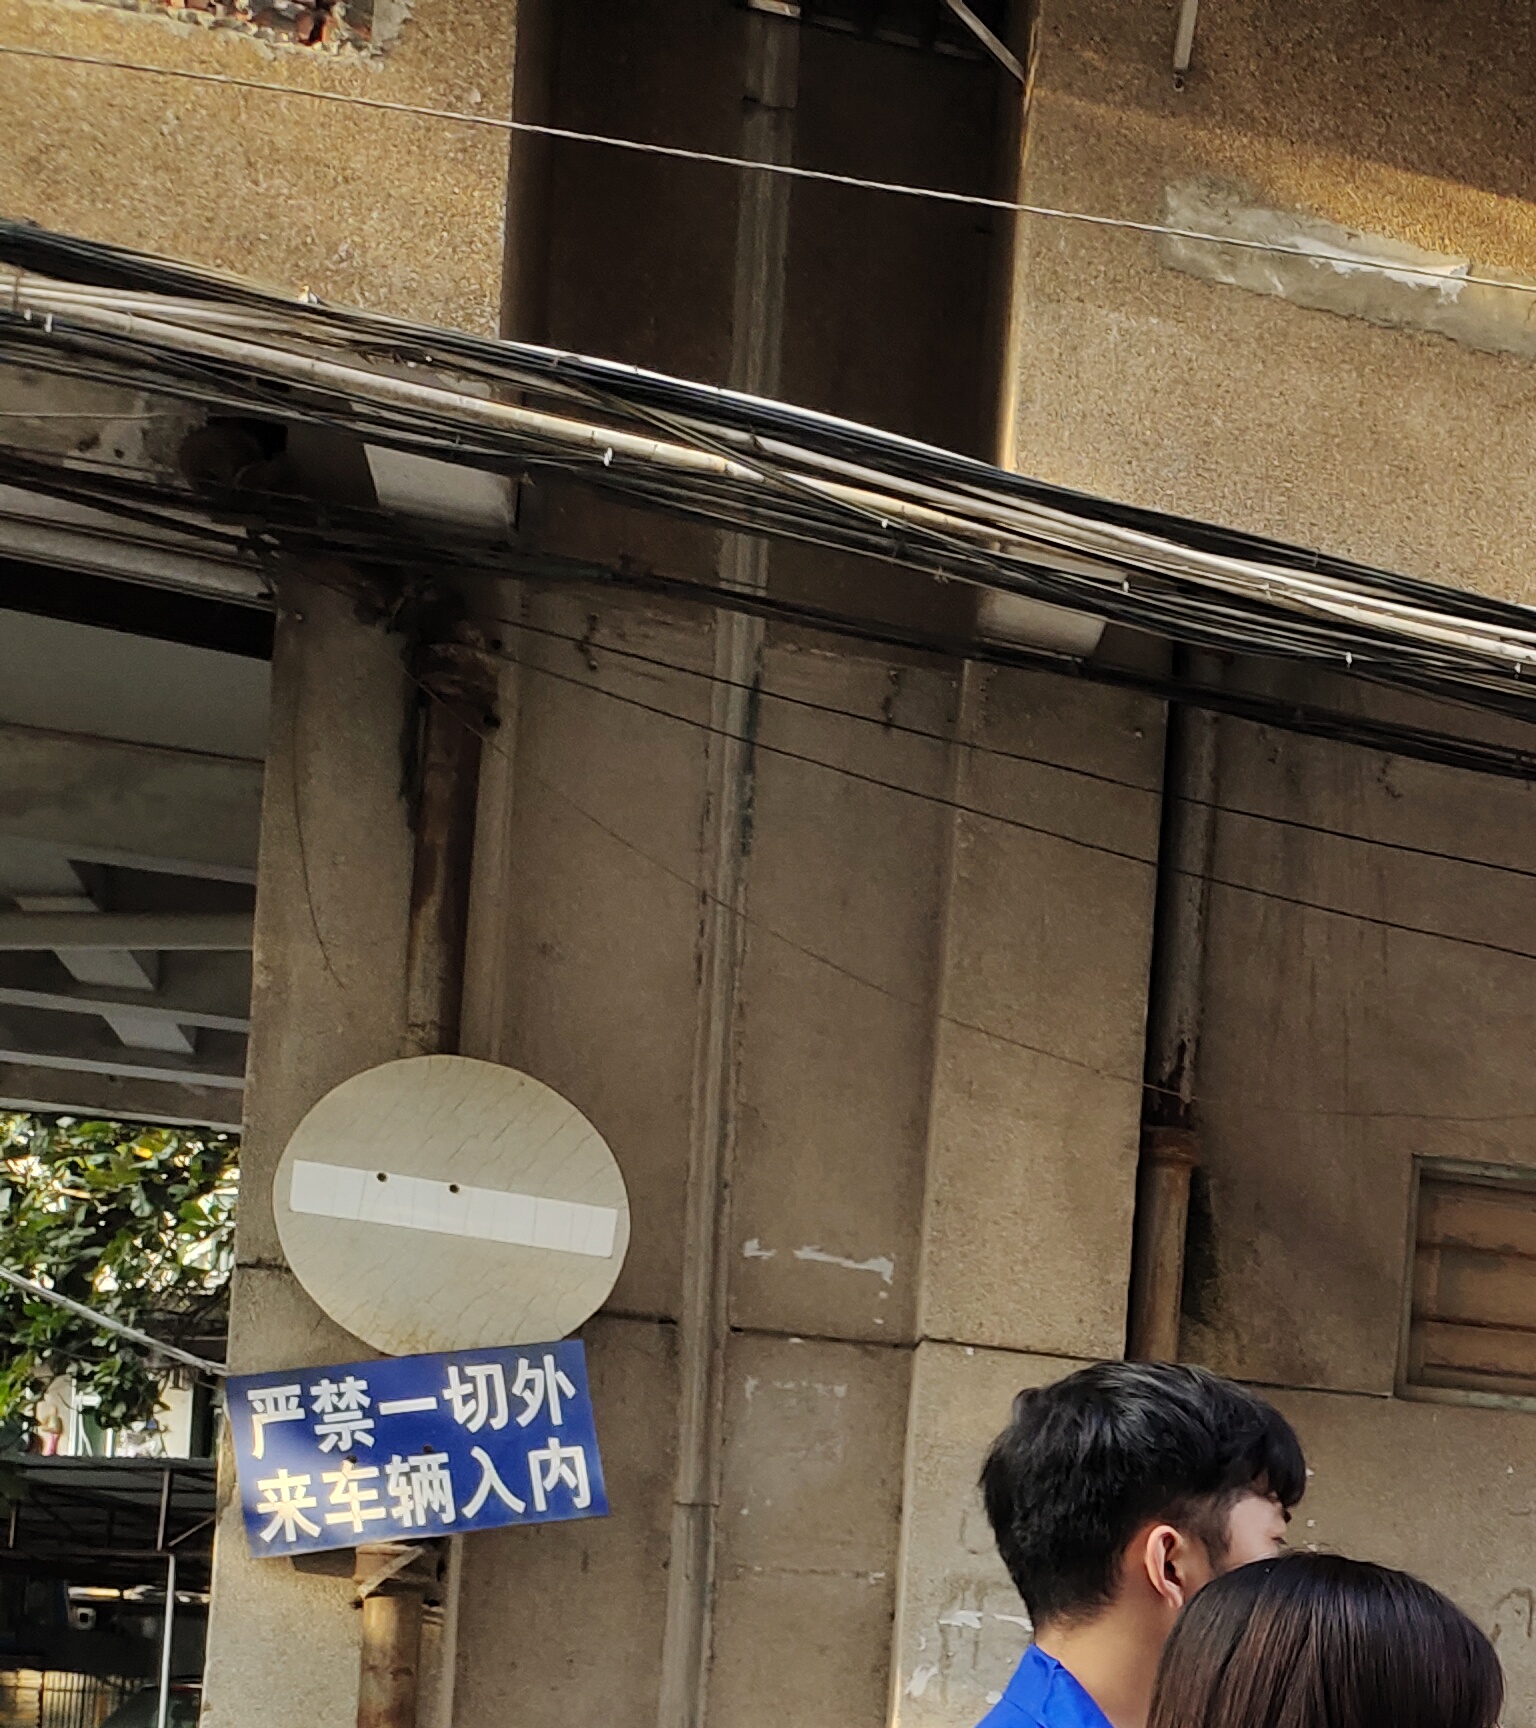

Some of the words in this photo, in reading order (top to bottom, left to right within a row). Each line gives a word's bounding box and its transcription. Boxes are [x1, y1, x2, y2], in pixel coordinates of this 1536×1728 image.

[246, 1353, 577, 1459] 严禁一切外
[257, 1437, 593, 1543] 来车辆入内
